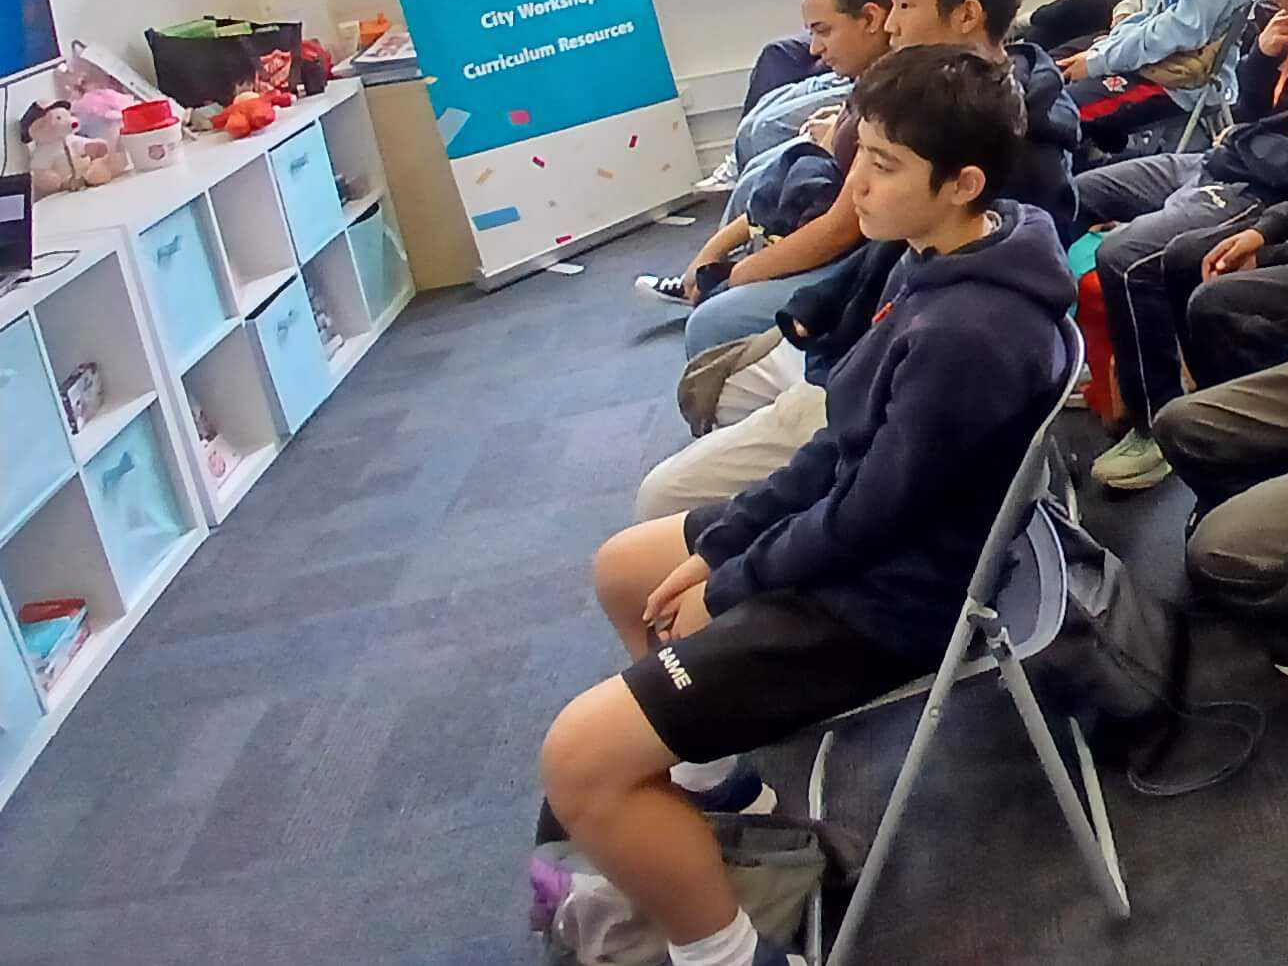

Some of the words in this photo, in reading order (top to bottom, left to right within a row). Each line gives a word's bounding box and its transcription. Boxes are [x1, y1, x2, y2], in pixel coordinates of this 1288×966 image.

[480, 10, 514, 29] City
[463, 42, 556, 79] Curriculum
[558, 21, 635, 52] Resources
